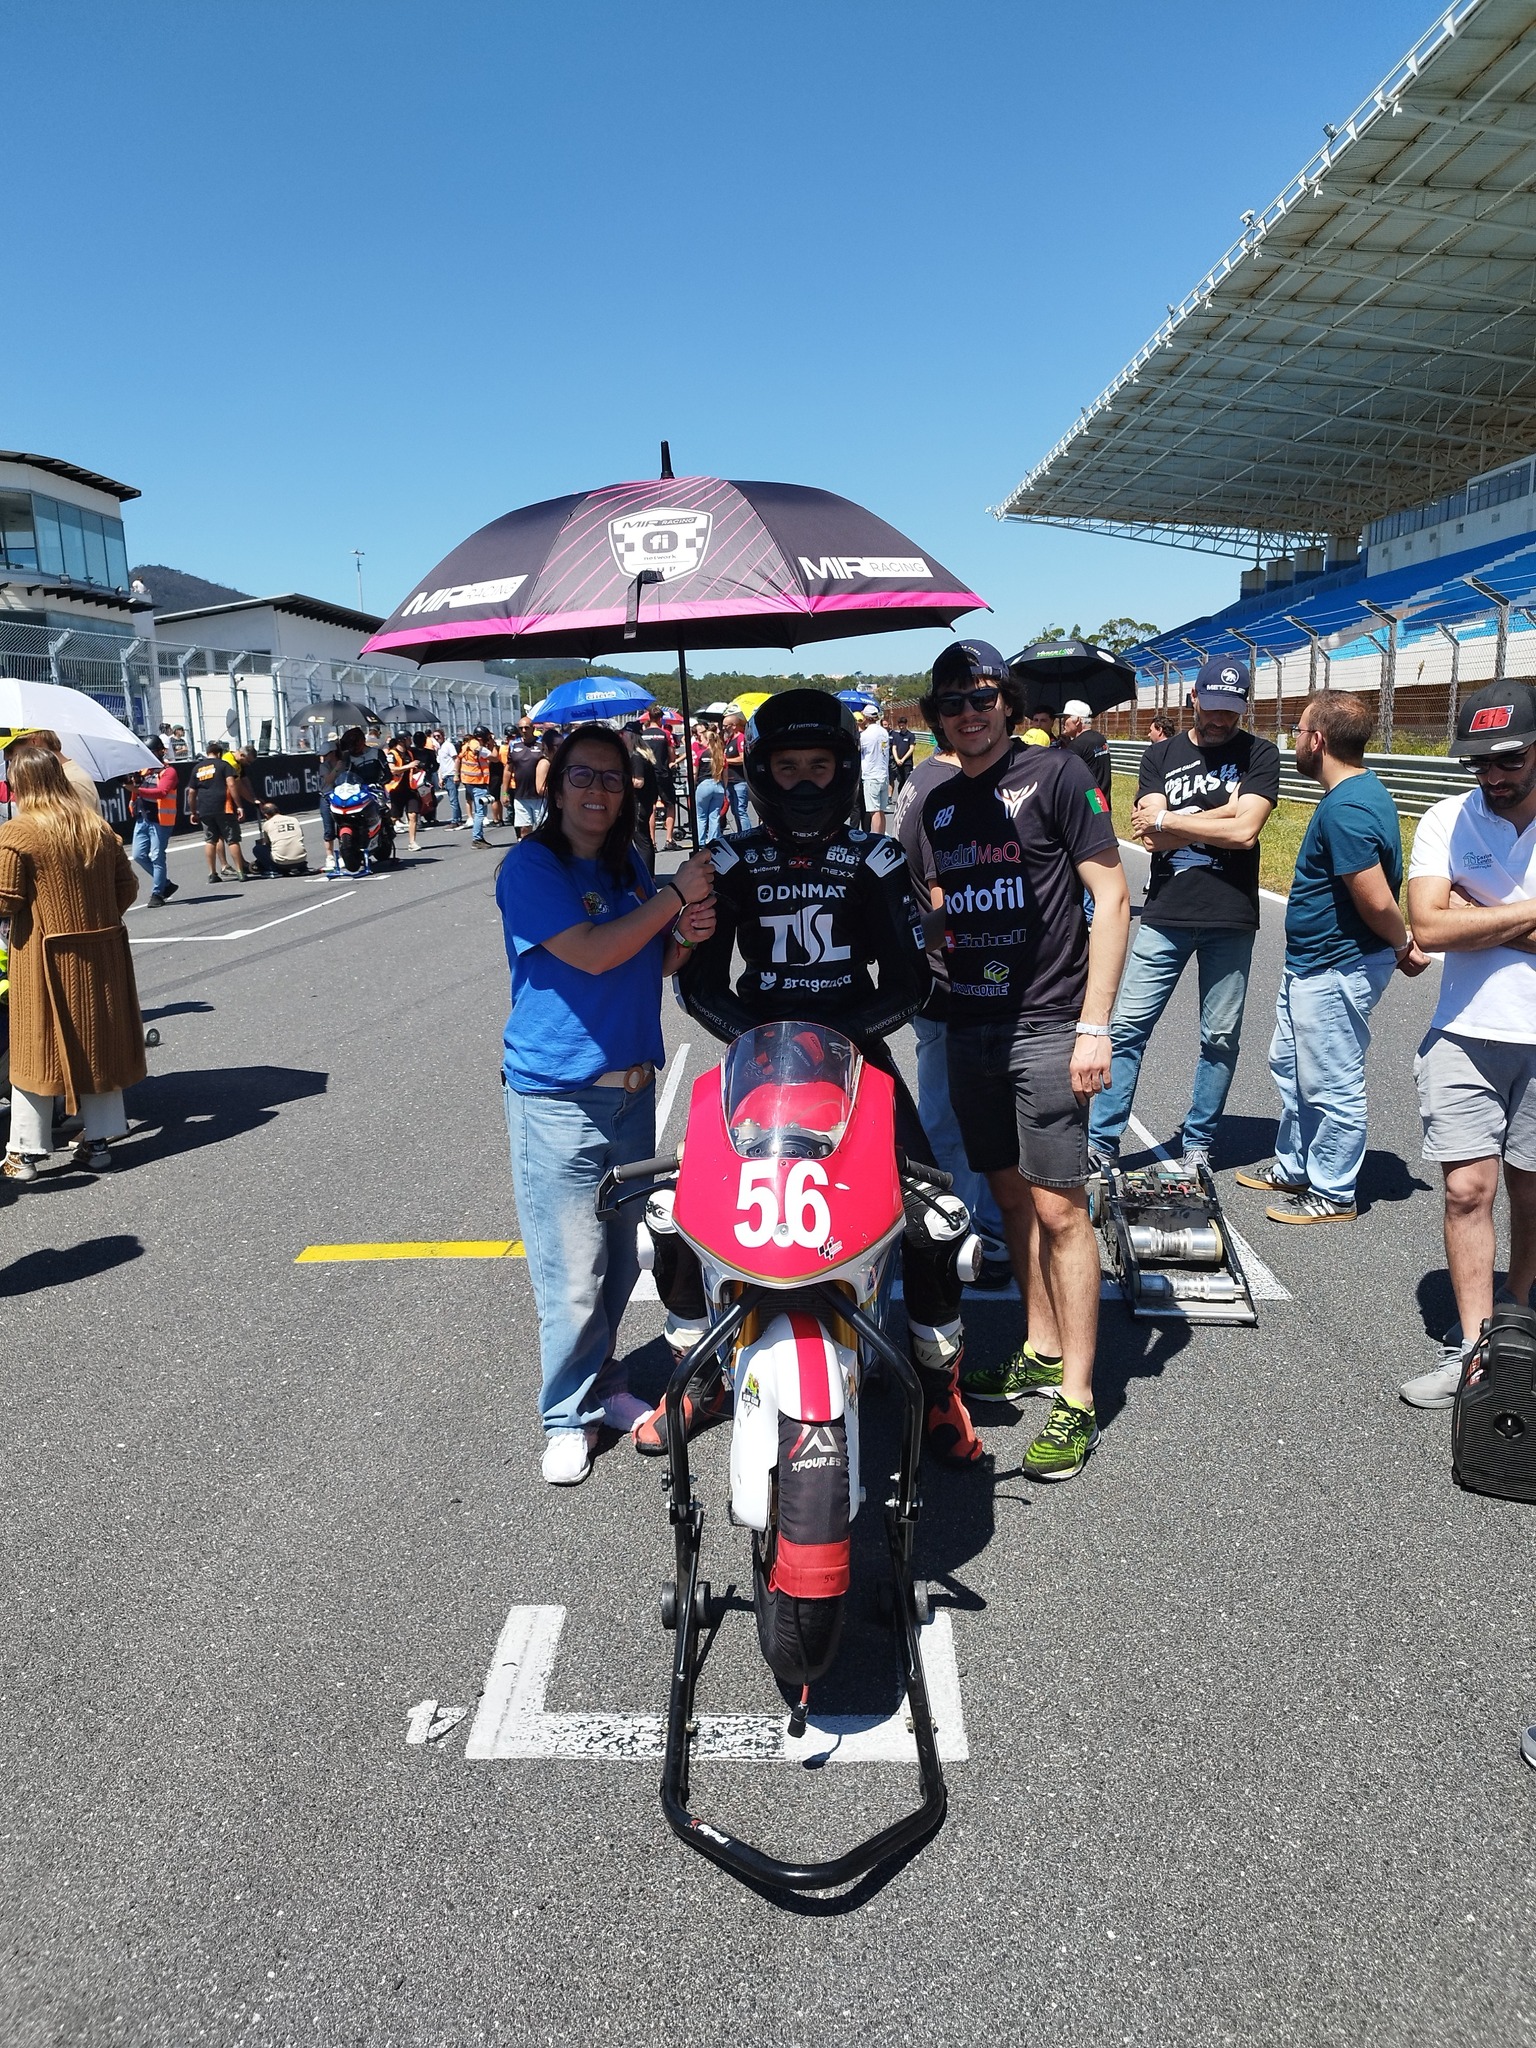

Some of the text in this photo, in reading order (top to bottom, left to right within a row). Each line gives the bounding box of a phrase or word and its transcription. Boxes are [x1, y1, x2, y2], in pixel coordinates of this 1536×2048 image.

[622, 517, 696, 529] MIR RACING
[798, 556, 925, 580] MIR RACING
[401, 586, 463, 617] MIR
[264, 773, 300, 798] Circuito
[278, 823, 295, 833] 26
[934, 804, 956, 831] 88
[777, 883, 847, 900] DNMAT
[759, 904, 851, 967] TSL
[955, 929, 1027, 949] Einhell
[782, 974, 852, 993] Bragança
[865, 1014, 903, 1035] TRANSPORTES
[733, 1160, 832, 1249] 56
[791, 1456, 842, 1473] XFOUR.ES
